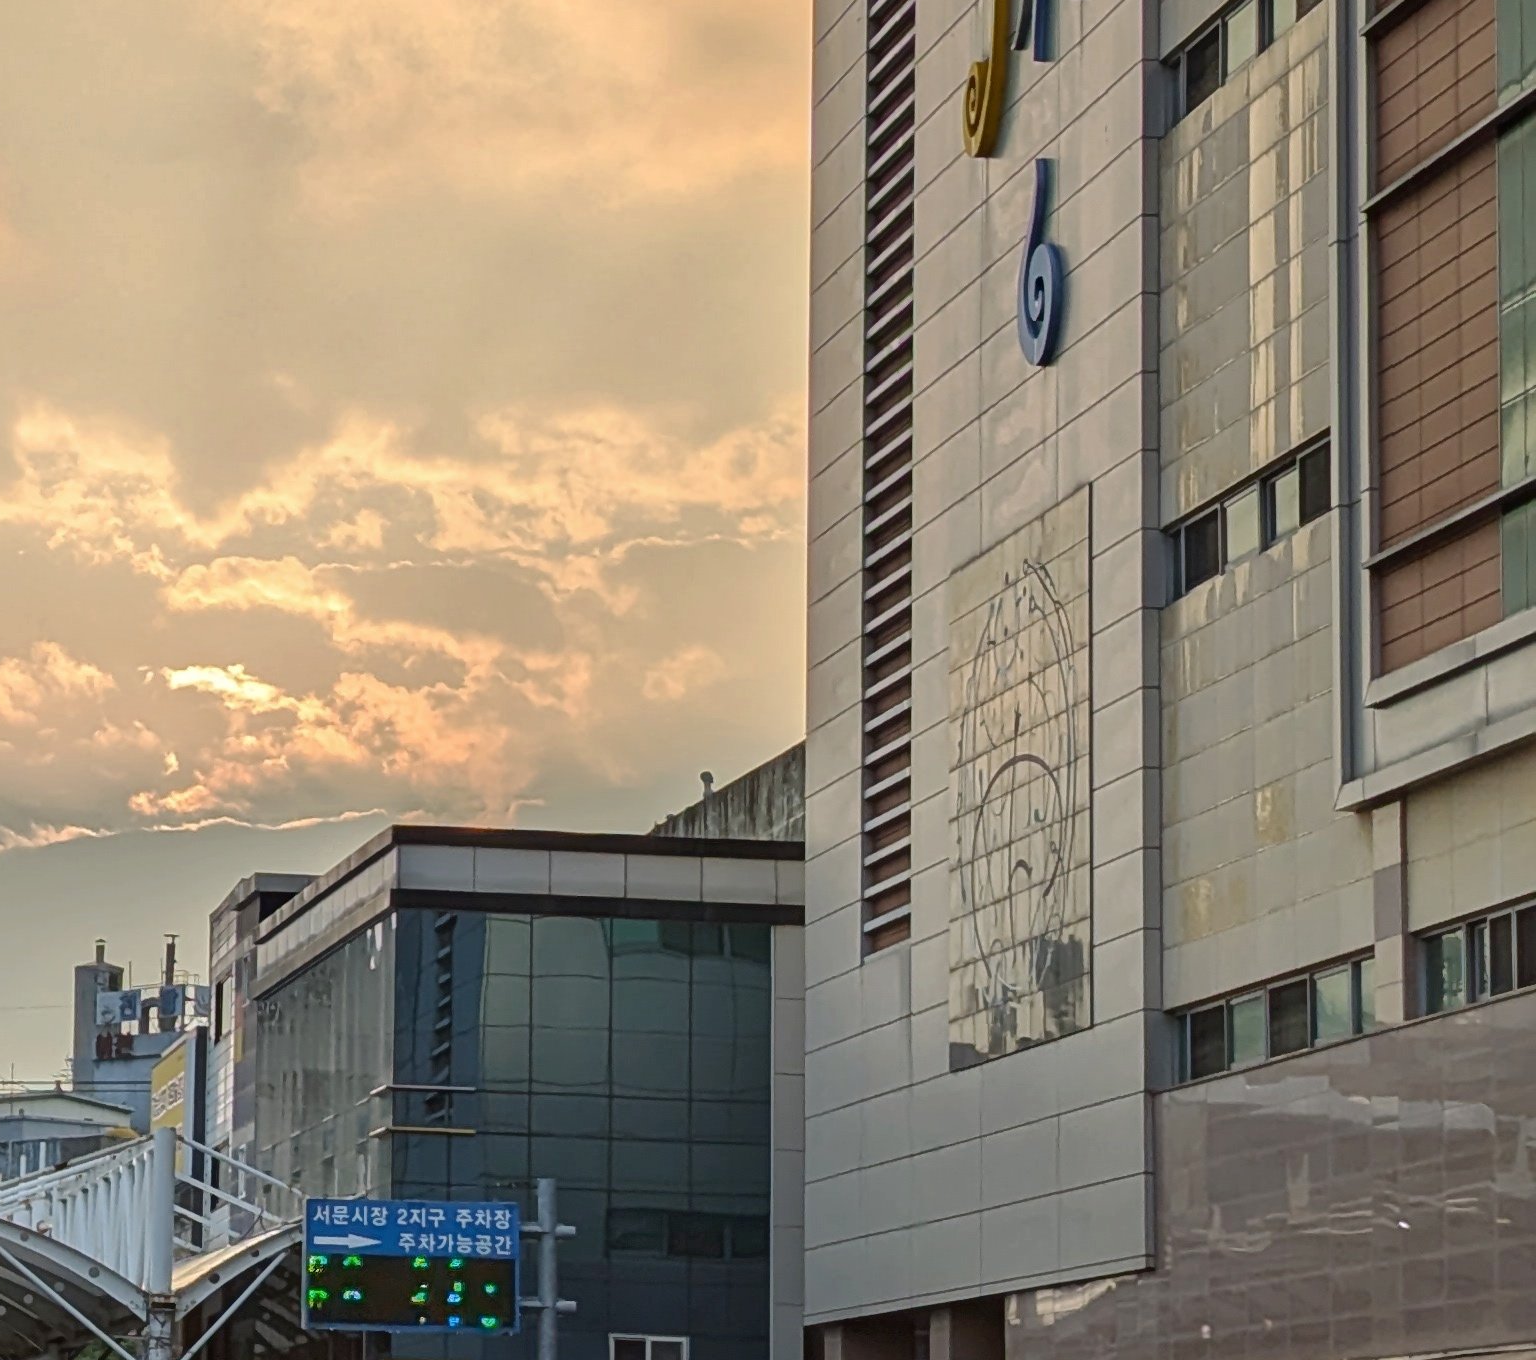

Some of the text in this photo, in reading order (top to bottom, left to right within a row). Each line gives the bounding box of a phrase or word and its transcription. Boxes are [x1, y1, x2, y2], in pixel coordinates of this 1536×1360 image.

[313, 1204, 512, 1230] 서문시장 2지구 주차장
[398, 1232, 513, 1256] 주차가능공간
